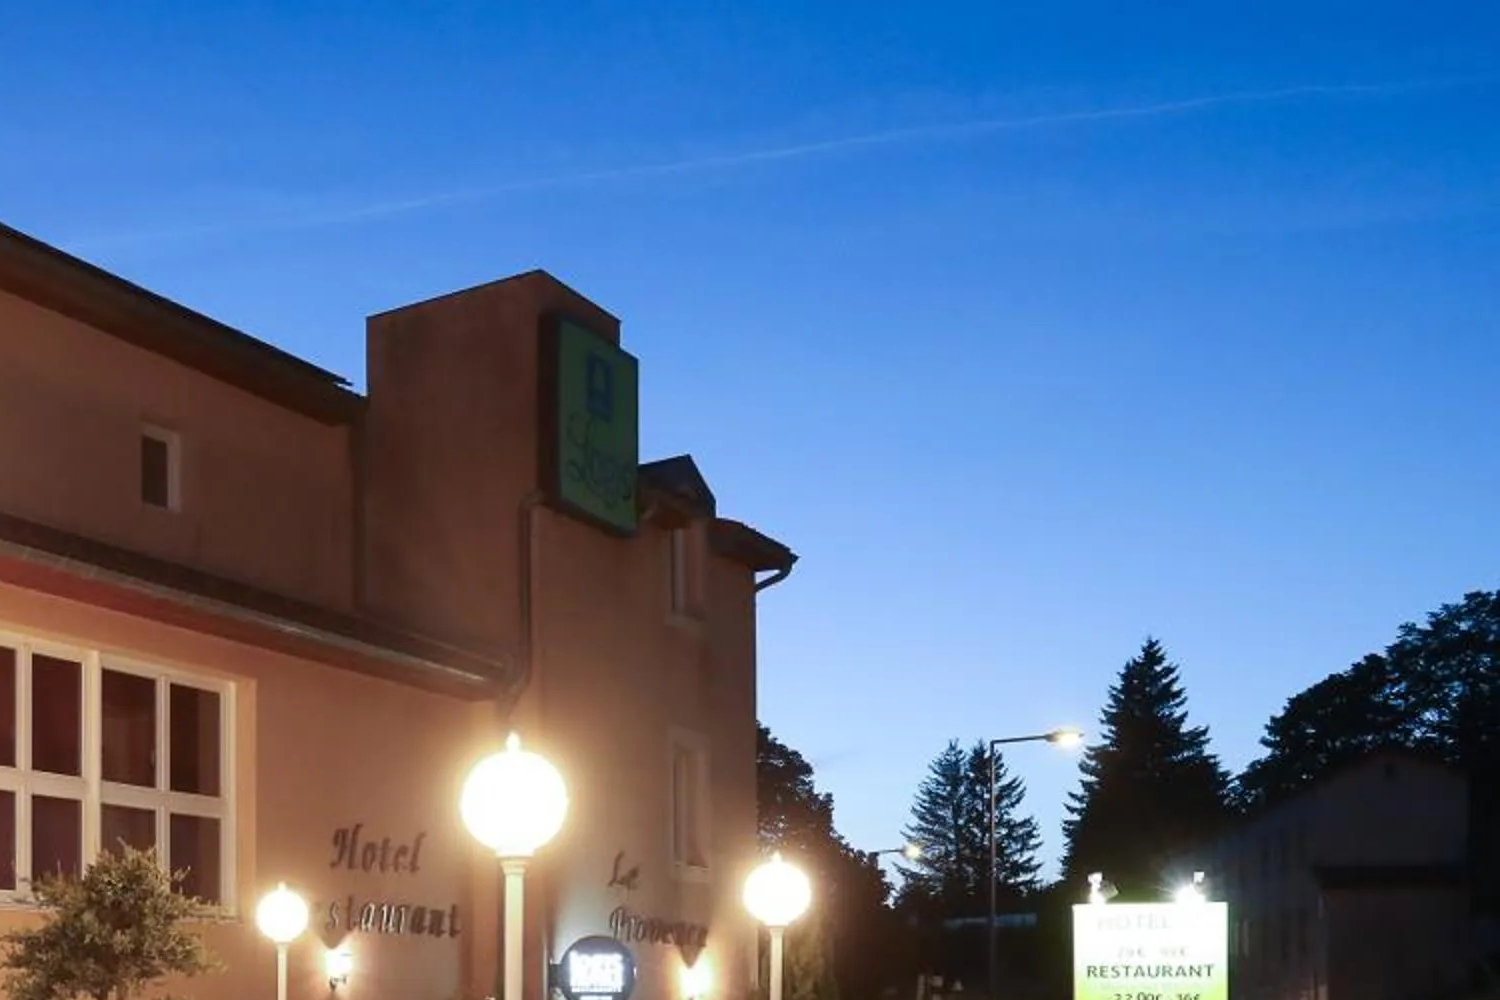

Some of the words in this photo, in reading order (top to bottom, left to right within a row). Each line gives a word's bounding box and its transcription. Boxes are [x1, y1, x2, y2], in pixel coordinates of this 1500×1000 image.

[329, 823, 427, 874] Hotel
[315, 895, 463, 939] staurant
[1086, 964, 1215, 979] RESTAURANT
